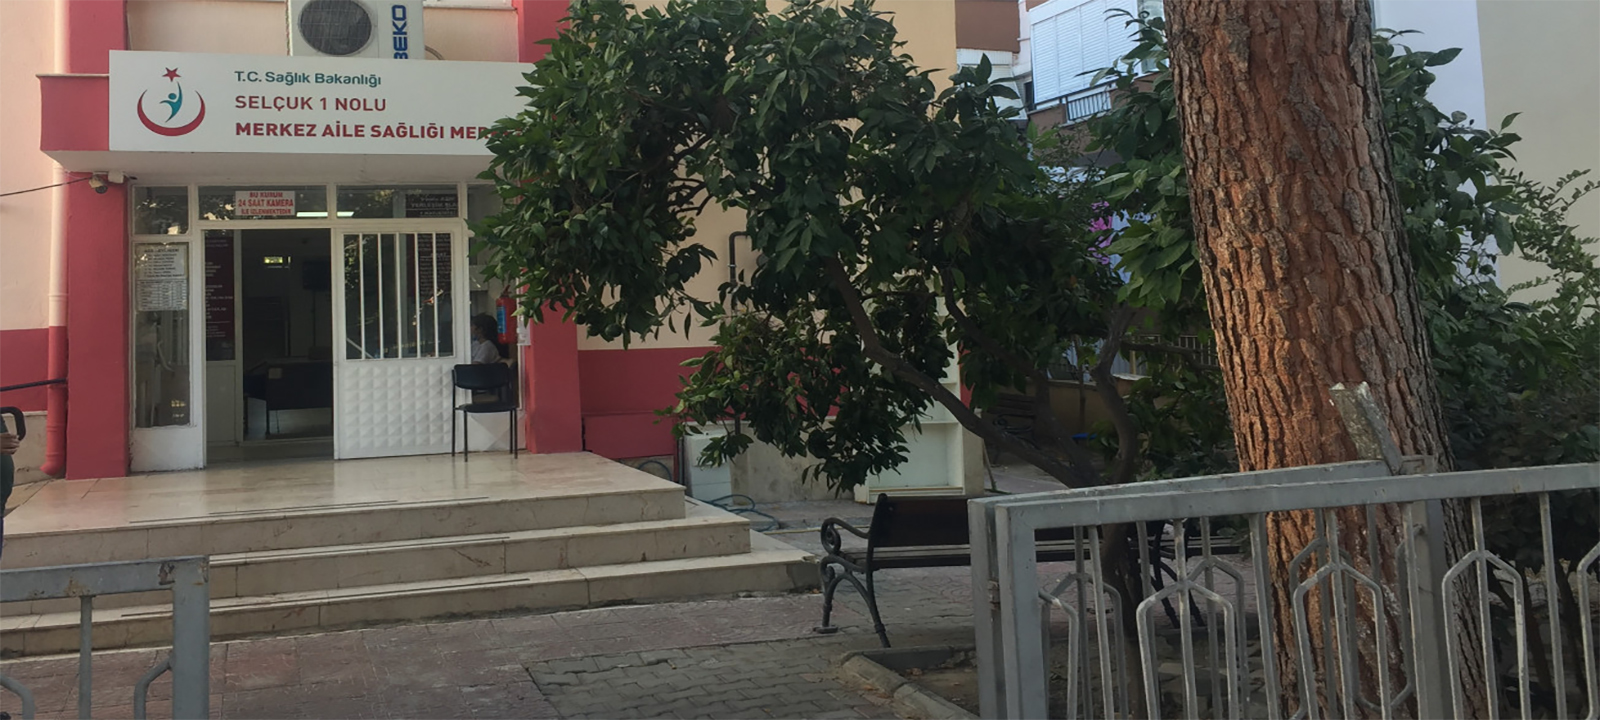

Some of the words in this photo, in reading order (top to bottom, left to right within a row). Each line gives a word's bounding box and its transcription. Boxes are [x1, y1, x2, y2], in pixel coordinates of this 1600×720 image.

[235, 71, 262, 82] T.C.
[265, 72, 311, 86] Sağlık
[314, 73, 382, 87] Bakanlığı
[235, 96, 313, 112] SELÇUK
[319, 98, 328, 110] 1
[335, 98, 387, 111] NOLU
[235, 123, 317, 137] MERKEZ
[322, 121, 365, 138] AİLE
[370, 122, 445, 139] SAĞLIĞI
[238, 199, 246, 207] 24
[248, 199, 265, 207] SAAT
[267, 199, 294, 207] KAMERA
